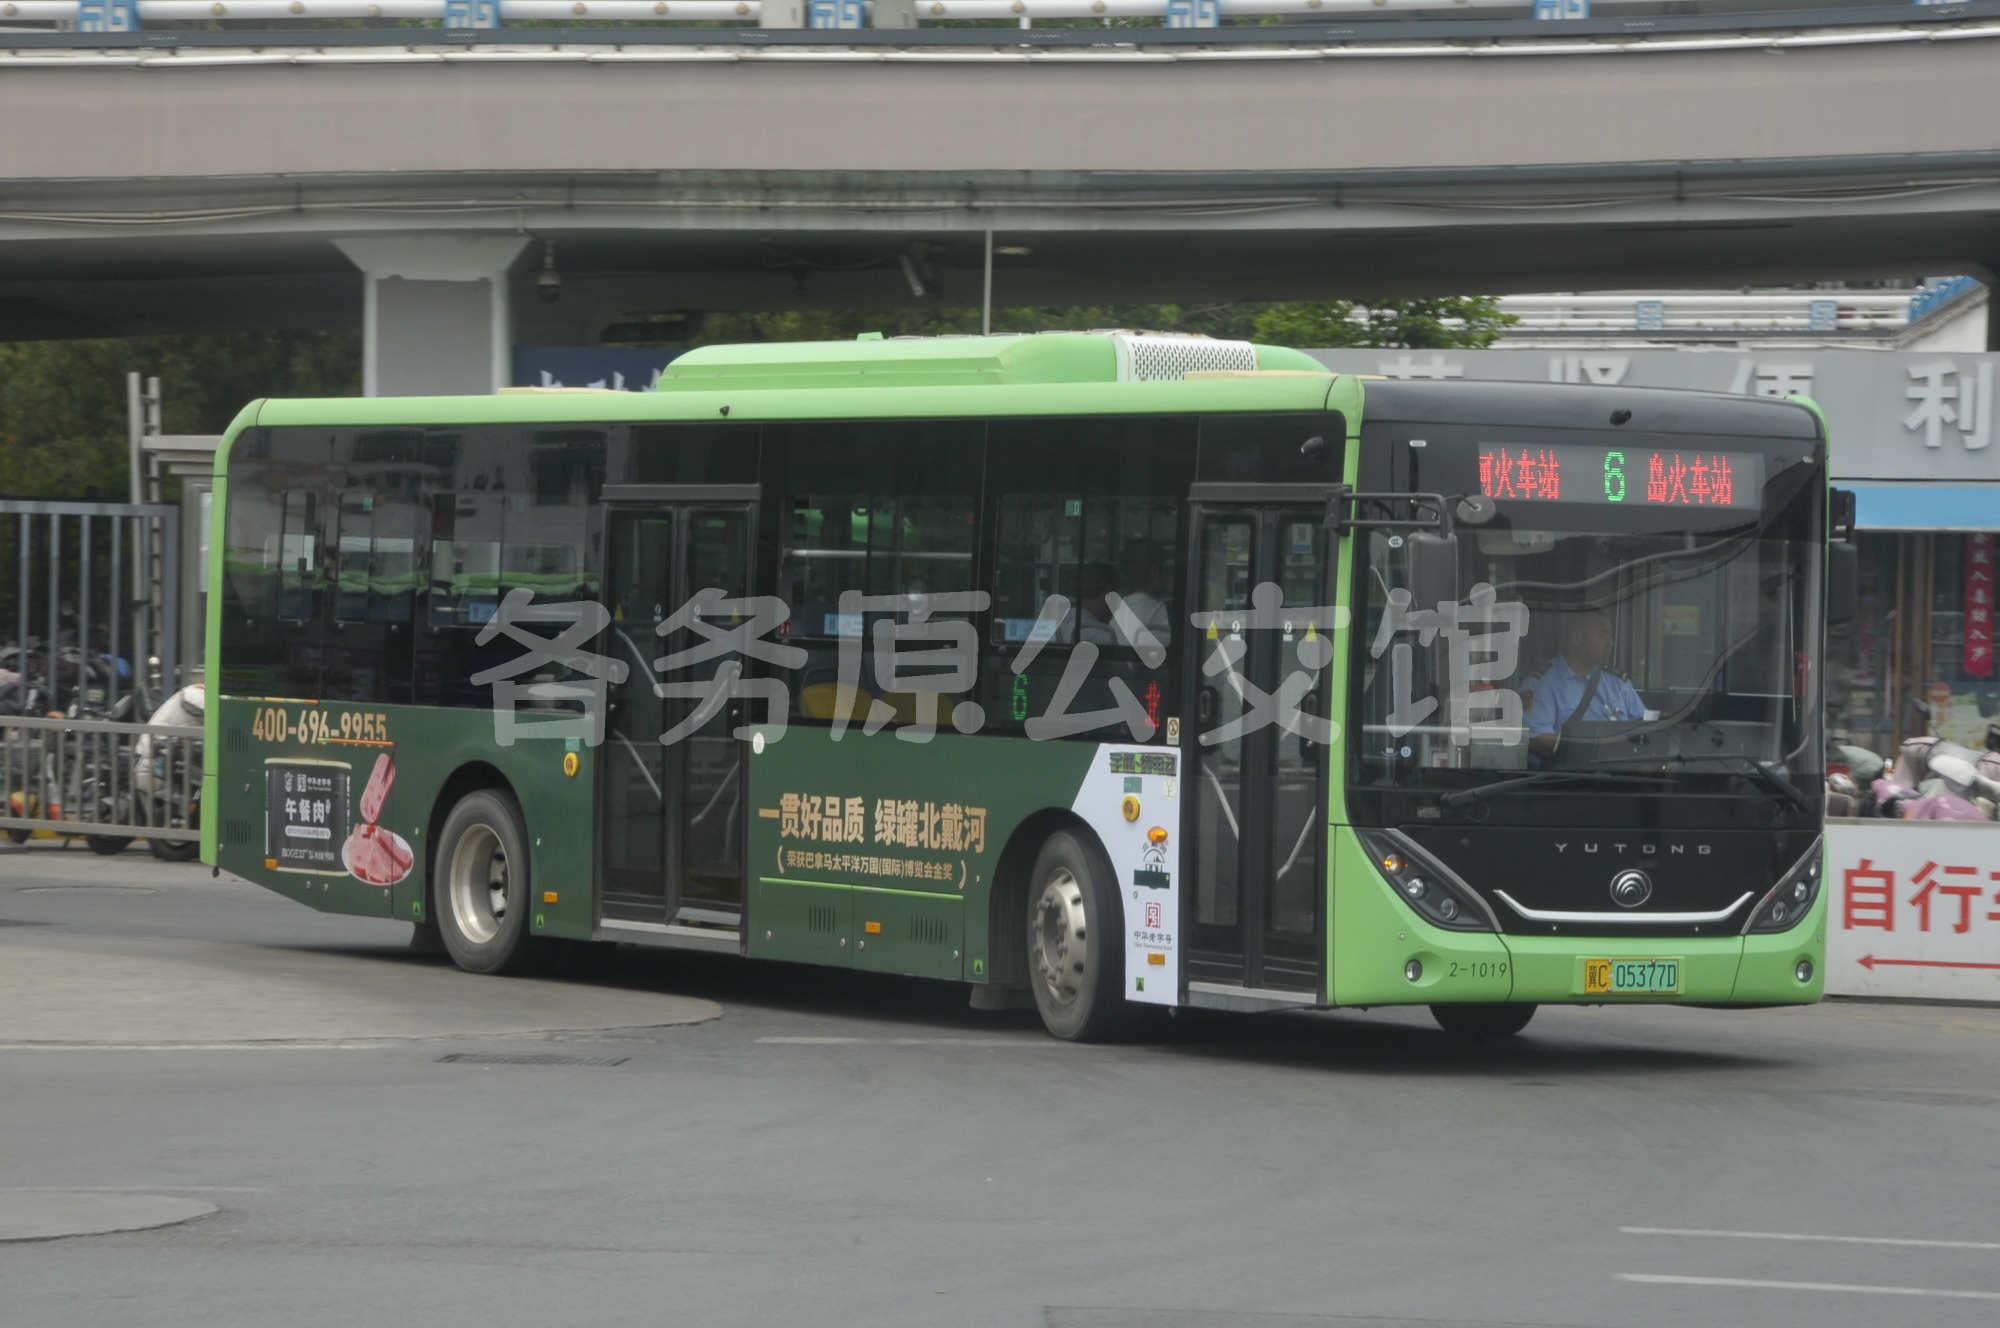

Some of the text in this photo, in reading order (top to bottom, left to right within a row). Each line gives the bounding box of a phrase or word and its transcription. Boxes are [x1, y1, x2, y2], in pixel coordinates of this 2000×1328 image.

[1604, 451, 1625, 501] 6
[1012, 673, 1028, 720] 6
[252, 707, 387, 748] 400-696-9955
[285, 798, 325, 823] 午餐肉
[758, 793, 987, 854] 一贯好品质 绿罐北戴河
[1555, 843, 1711, 855] YUTONG
[1843, 858, 2000, 934] 自行
[1133, 931, 1172, 944] 中华老字号
[1450, 962, 1507, 978] 2-1019
